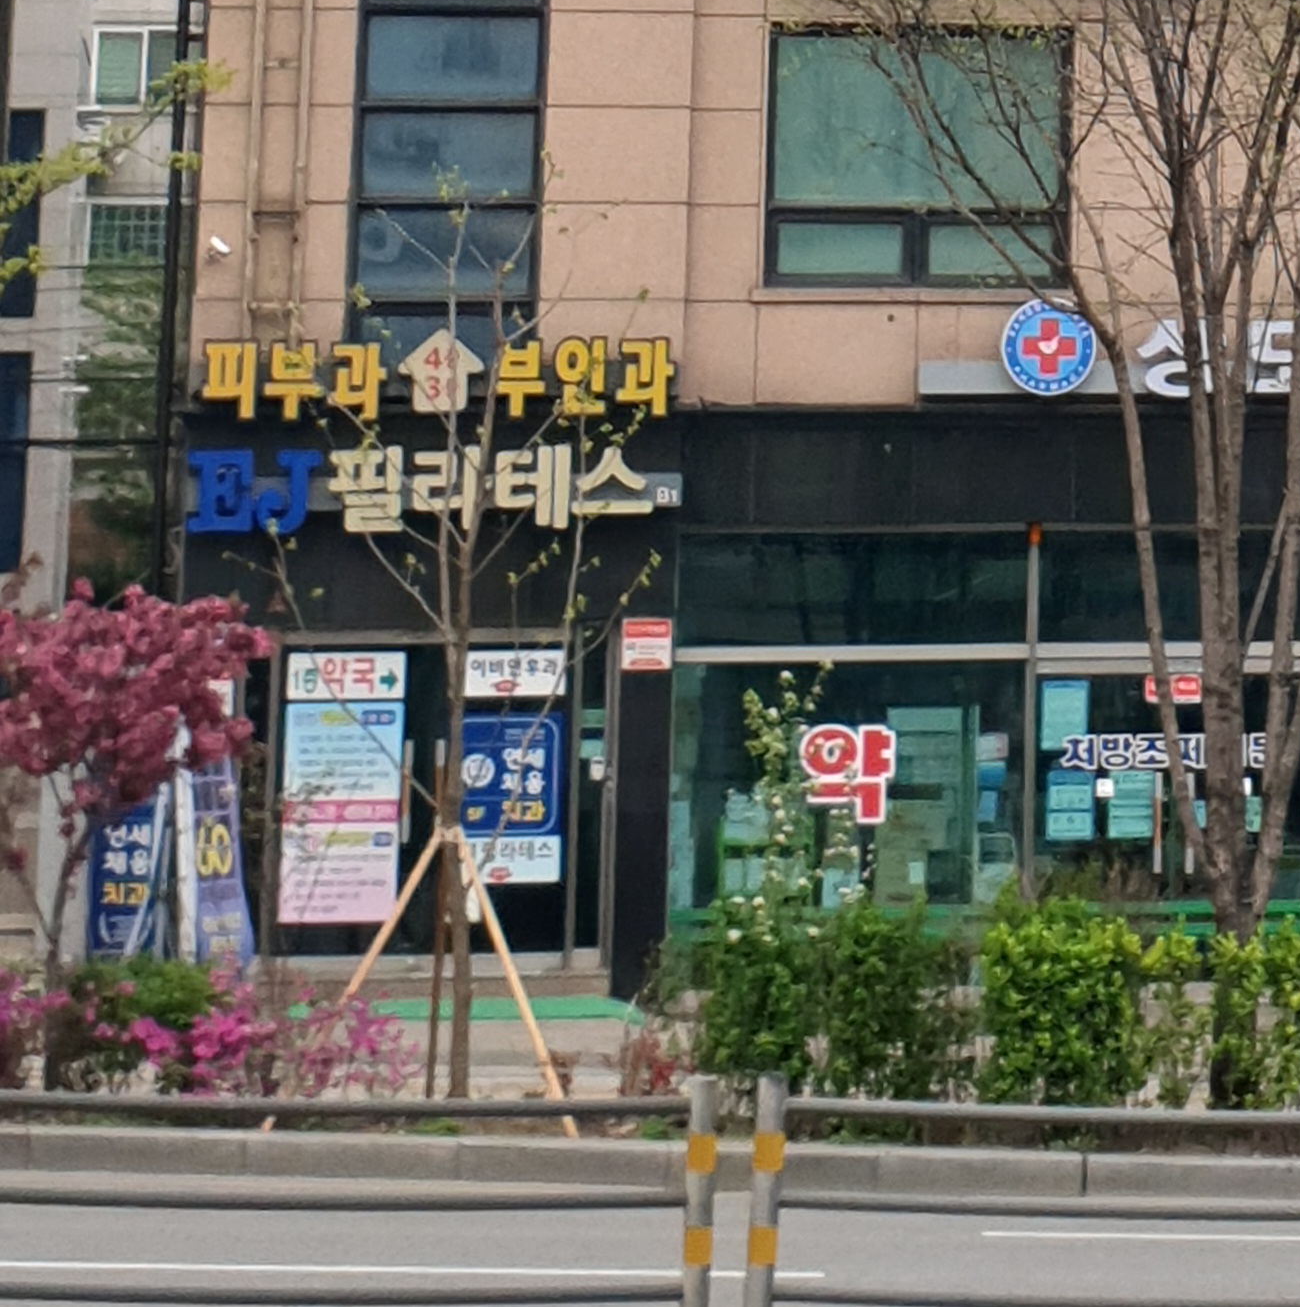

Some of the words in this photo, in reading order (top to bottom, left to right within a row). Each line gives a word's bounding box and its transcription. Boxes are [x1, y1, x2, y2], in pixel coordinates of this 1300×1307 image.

[201, 339, 388, 420] 피부과
[496, 337, 675, 418] 부인과
[187, 449, 323, 534] EJ
[328, 445, 654, 534] 필라테스
[323, 657, 376, 694] 약국
[800, 724, 897, 824] 약
